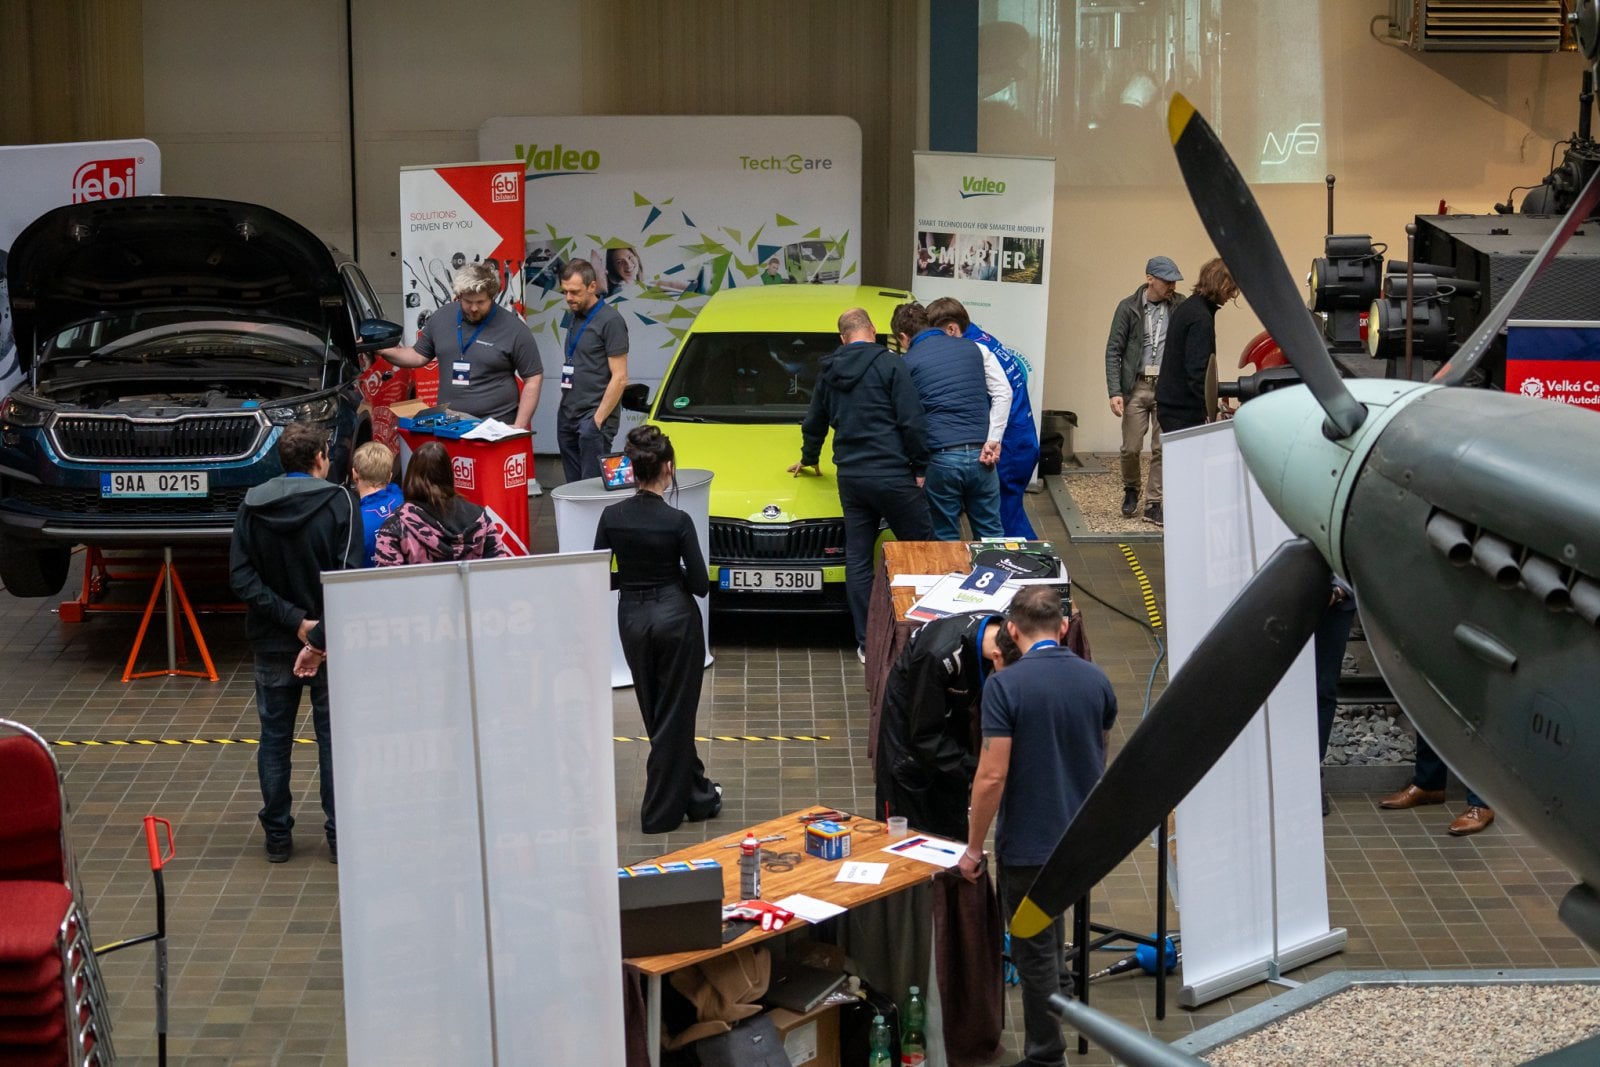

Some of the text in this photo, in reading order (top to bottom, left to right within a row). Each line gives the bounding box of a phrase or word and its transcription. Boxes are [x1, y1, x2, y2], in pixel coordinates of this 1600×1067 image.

[515, 144, 600, 171] Valeo
[72, 163, 134, 205] febi
[493, 175, 517, 194] febi
[962, 176, 1006, 194] Valeo
[410, 210, 456, 221] SOLUTIONS
[410, 220, 473, 232] DRIVEN BY YOU
[918, 219, 1045, 233] SMART TECHNOLOGY FOR SMARTER MOBILITY
[1546, 380, 1600, 392] Velká Ce
[1567, 394, 1600, 405] Autodí
[504, 457, 526, 478] febi
[115, 475, 145, 492] 9AA
[158, 474, 200, 491] 0215
[733, 572, 762, 587] EL3
[775, 573, 814, 588] 53BU
[975, 571, 994, 589] 8
[956, 592, 984, 604] Valeo
[1532, 712, 1562, 747] OIL
